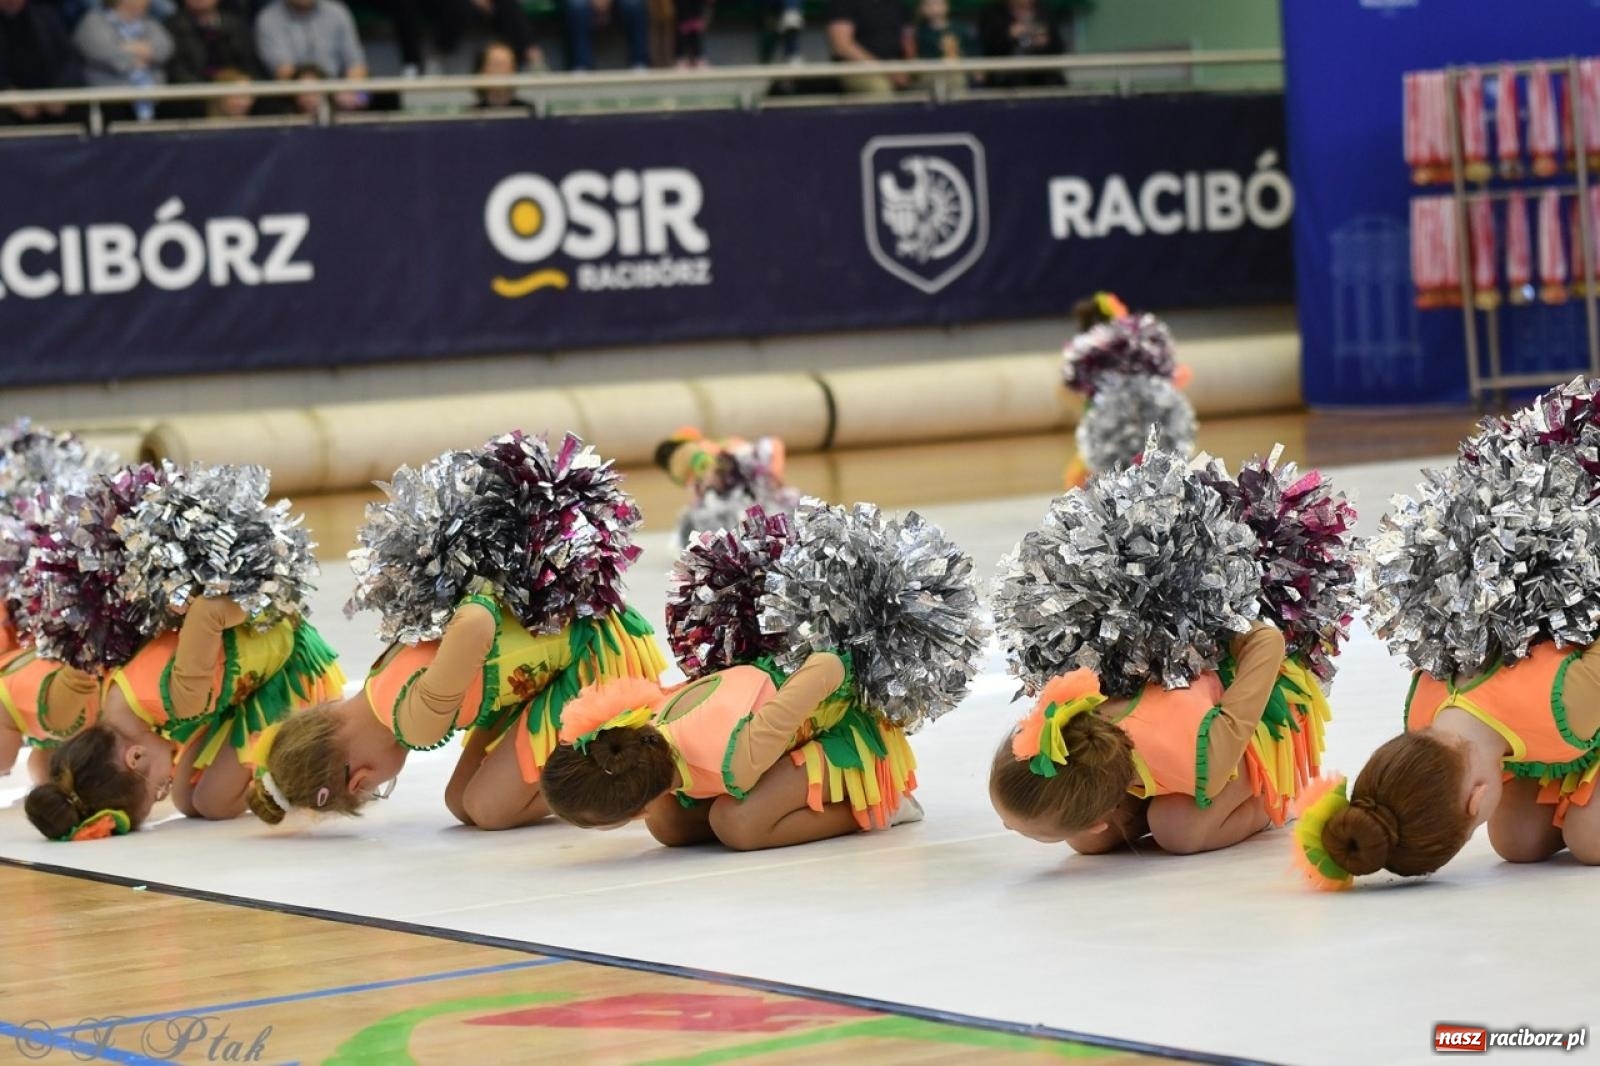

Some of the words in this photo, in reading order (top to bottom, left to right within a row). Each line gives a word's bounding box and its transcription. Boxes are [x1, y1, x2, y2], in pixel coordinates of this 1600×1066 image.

[0, 199, 313, 299] CIBÓRZ
[484, 168, 709, 264] OSiR
[577, 255, 712, 290] RACIBÓRZ
